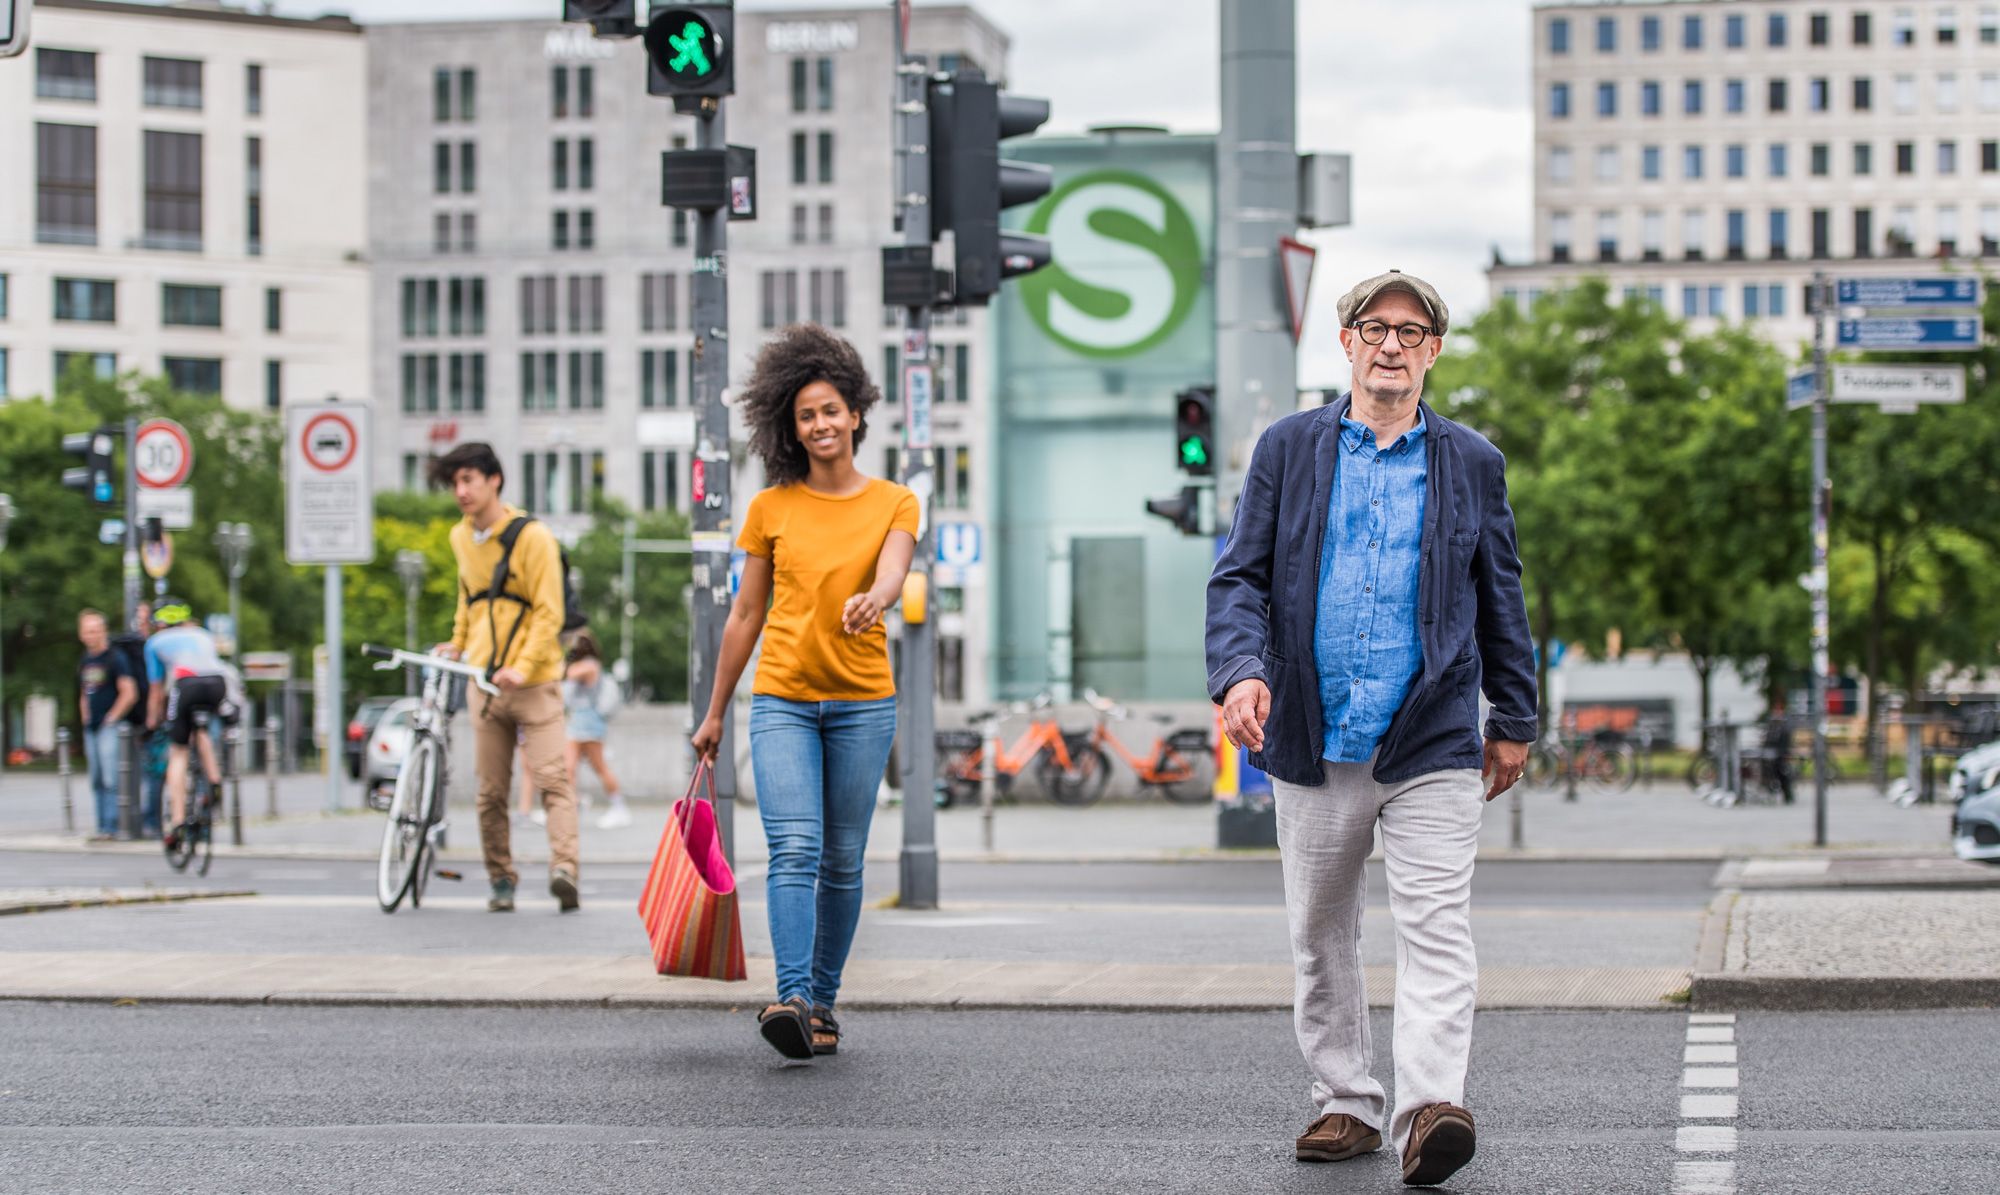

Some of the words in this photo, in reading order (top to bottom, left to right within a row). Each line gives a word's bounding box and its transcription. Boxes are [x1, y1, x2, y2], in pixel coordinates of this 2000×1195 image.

[1047, 182, 1177, 348] S
[141, 442, 174, 472] 30
[942, 522, 976, 565] U
